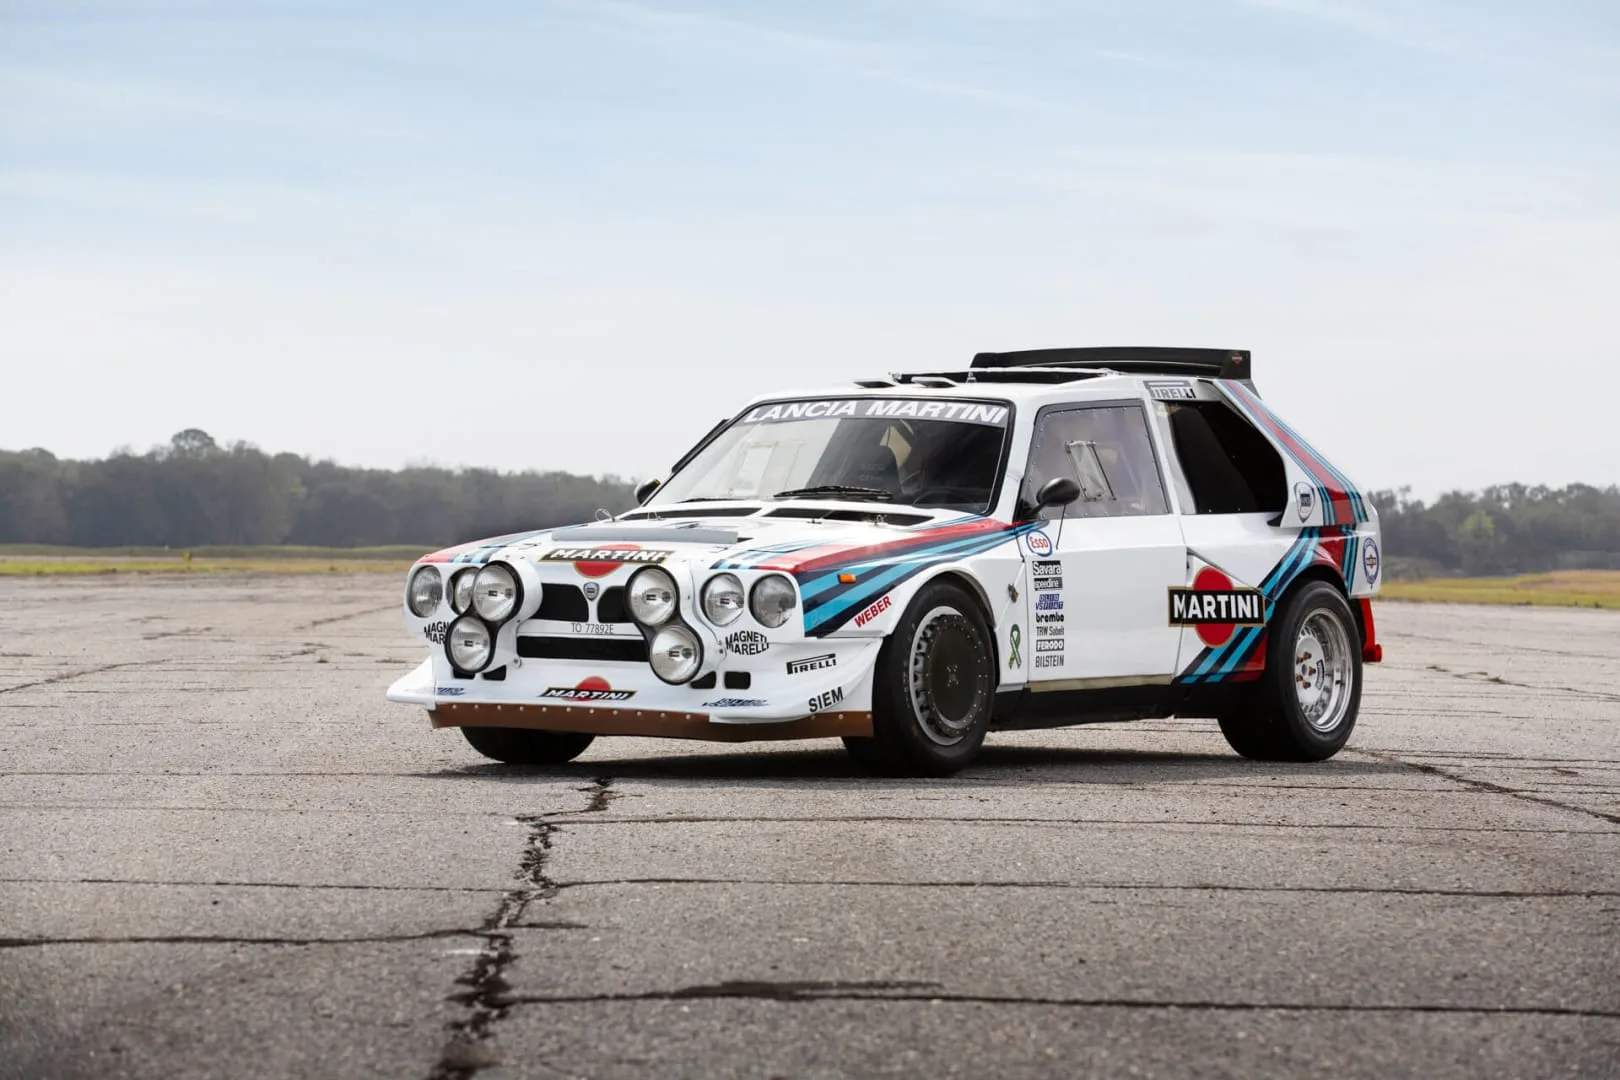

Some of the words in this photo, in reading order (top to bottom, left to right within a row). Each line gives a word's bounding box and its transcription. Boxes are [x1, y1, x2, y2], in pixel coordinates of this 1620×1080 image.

[1144, 381, 1197, 399] PIRELLI
[744, 401, 856, 424] LANCIA
[865, 399, 1007, 424] MARTINI
[550, 548, 667, 562] MARTINI
[1033, 561, 1062, 576] Savara
[854, 596, 892, 628] WEBER
[1173, 593, 1259, 620] MARTINI
[1036, 612, 1064, 623] brembo
[424, 621, 450, 634] MAGN
[571, 622, 582, 633] TO
[585, 623, 615, 634] 77892E
[1036, 626, 1048, 637] TRW
[725, 630, 768, 648] MAGNETI
[1037, 639, 1064, 650] FERODO
[726, 641, 770, 656] MARELLI
[786, 653, 837, 675] PIRELLI
[1036, 655, 1065, 668] BILSTEIN
[546, 688, 629, 700] MARTINI
[808, 686, 844, 713] SIEM
